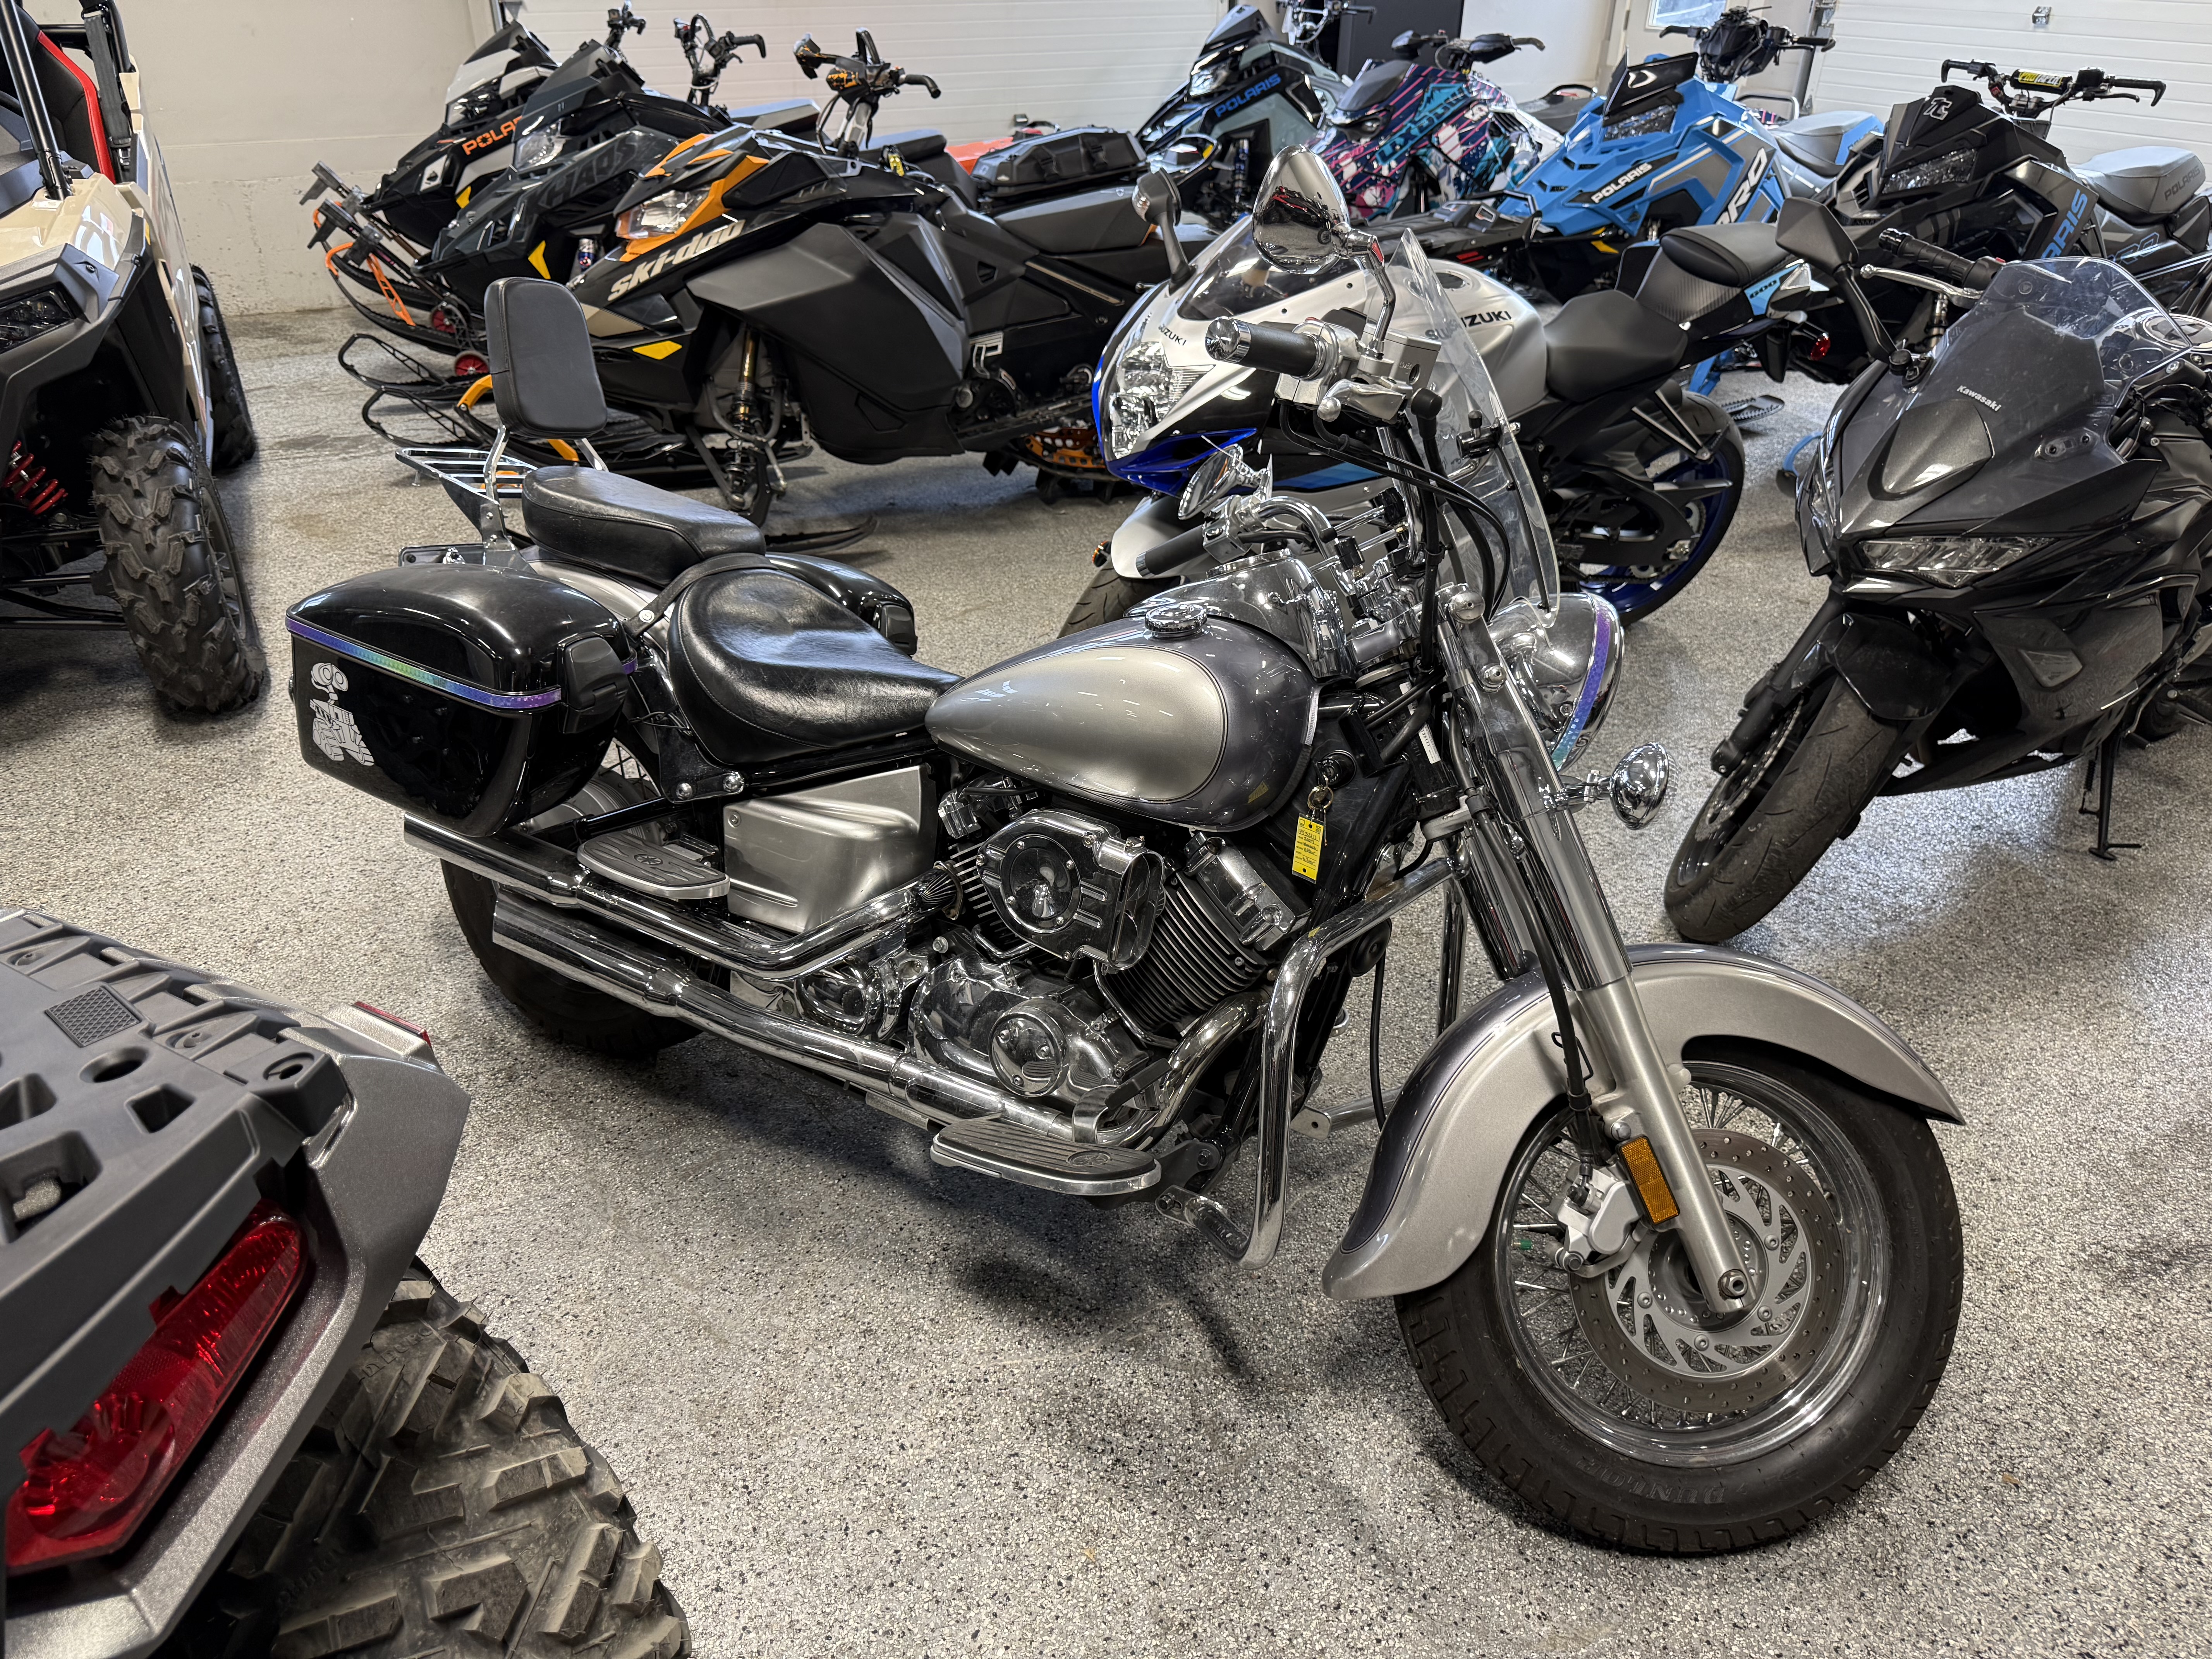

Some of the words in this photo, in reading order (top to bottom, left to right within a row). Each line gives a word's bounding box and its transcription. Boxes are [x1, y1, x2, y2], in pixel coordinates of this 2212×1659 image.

[1215, 74, 1281, 117] POLARIS
[462, 115, 523, 155] POLA
[1591, 162, 1652, 203] POLARIS
[2164, 165, 2201, 201] POLARIS
[2040, 189, 2088, 265] ARIS
[1158, 324, 1187, 346] SUZUKI
[1956, 385, 2002, 411] Kawasaki
